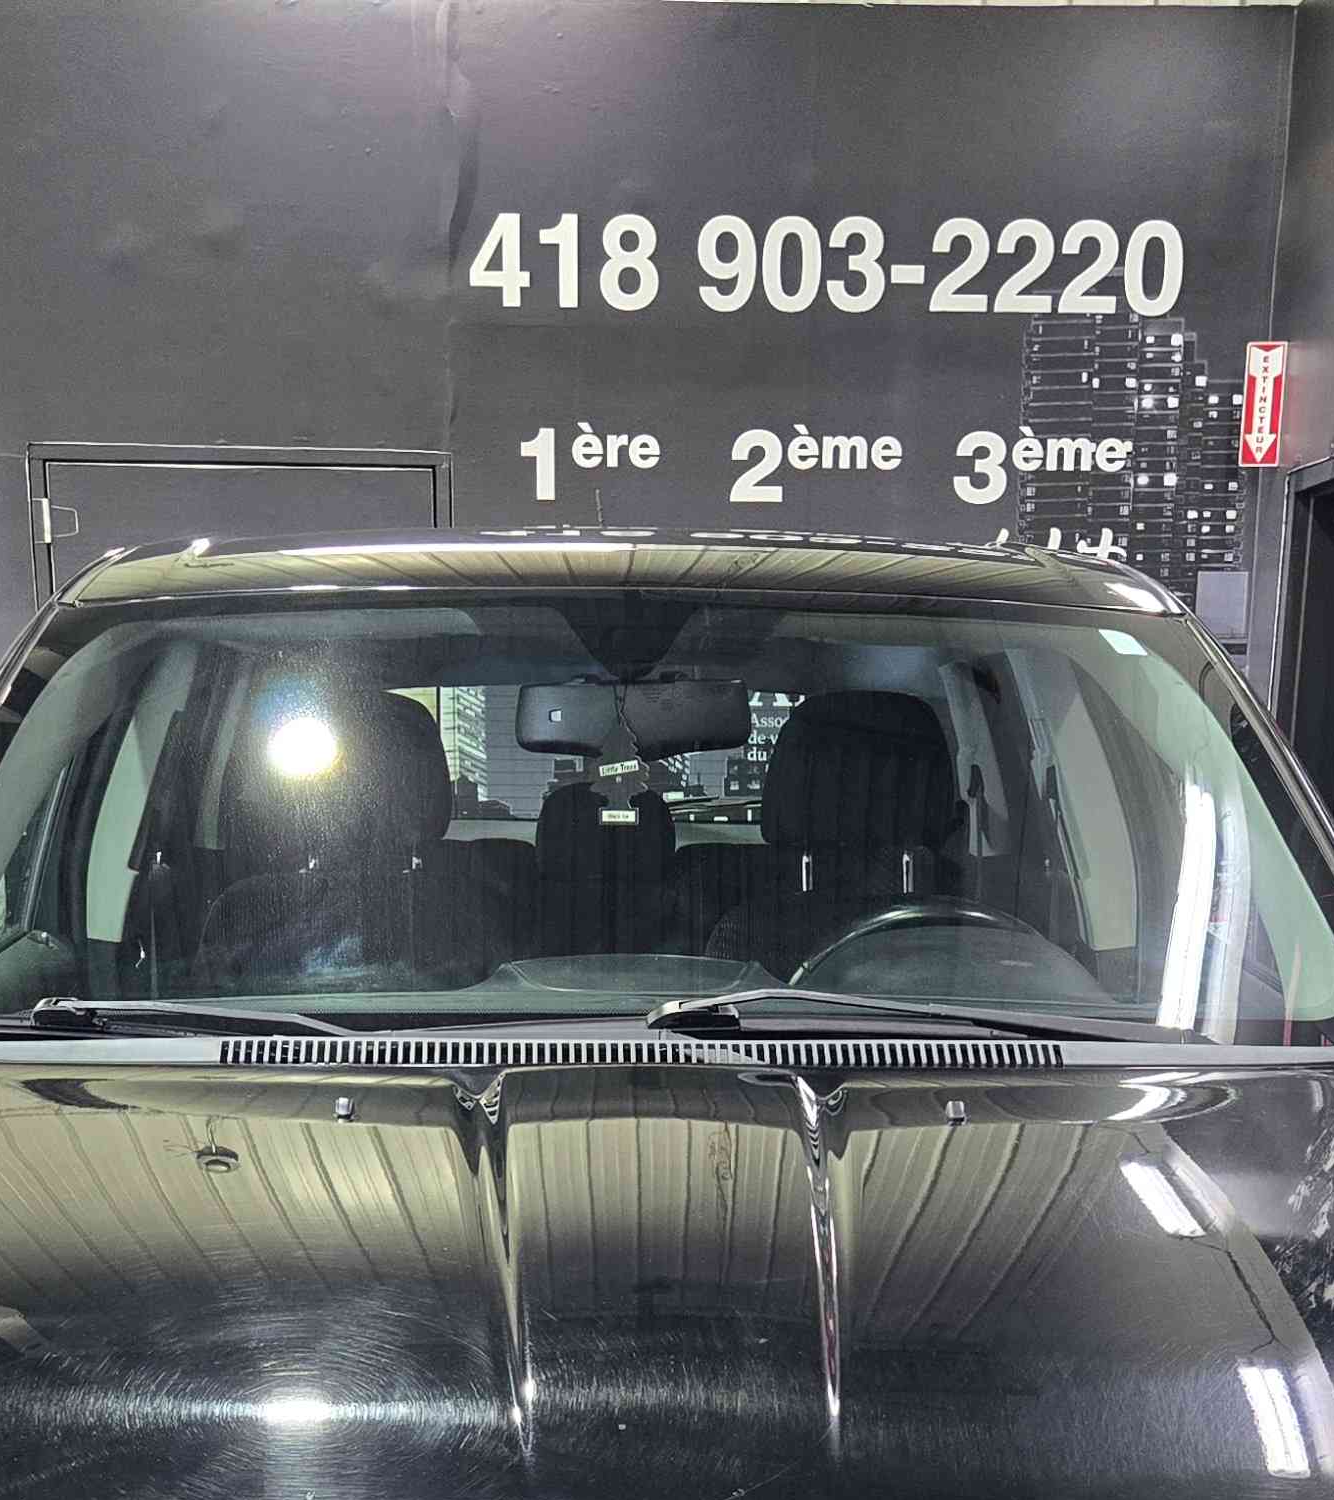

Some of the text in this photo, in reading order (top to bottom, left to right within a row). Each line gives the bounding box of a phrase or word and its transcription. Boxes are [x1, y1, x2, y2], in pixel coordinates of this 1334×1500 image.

[469, 212, 1185, 316] 418 903-2220
[1255, 355, 1269, 453] EXTINCTEUR
[519, 421, 1133, 506] 1ère 2ème 3ème
[748, 729, 767, 745] de
[750, 712, 789, 729] Asso
[747, 746, 768, 761] du
